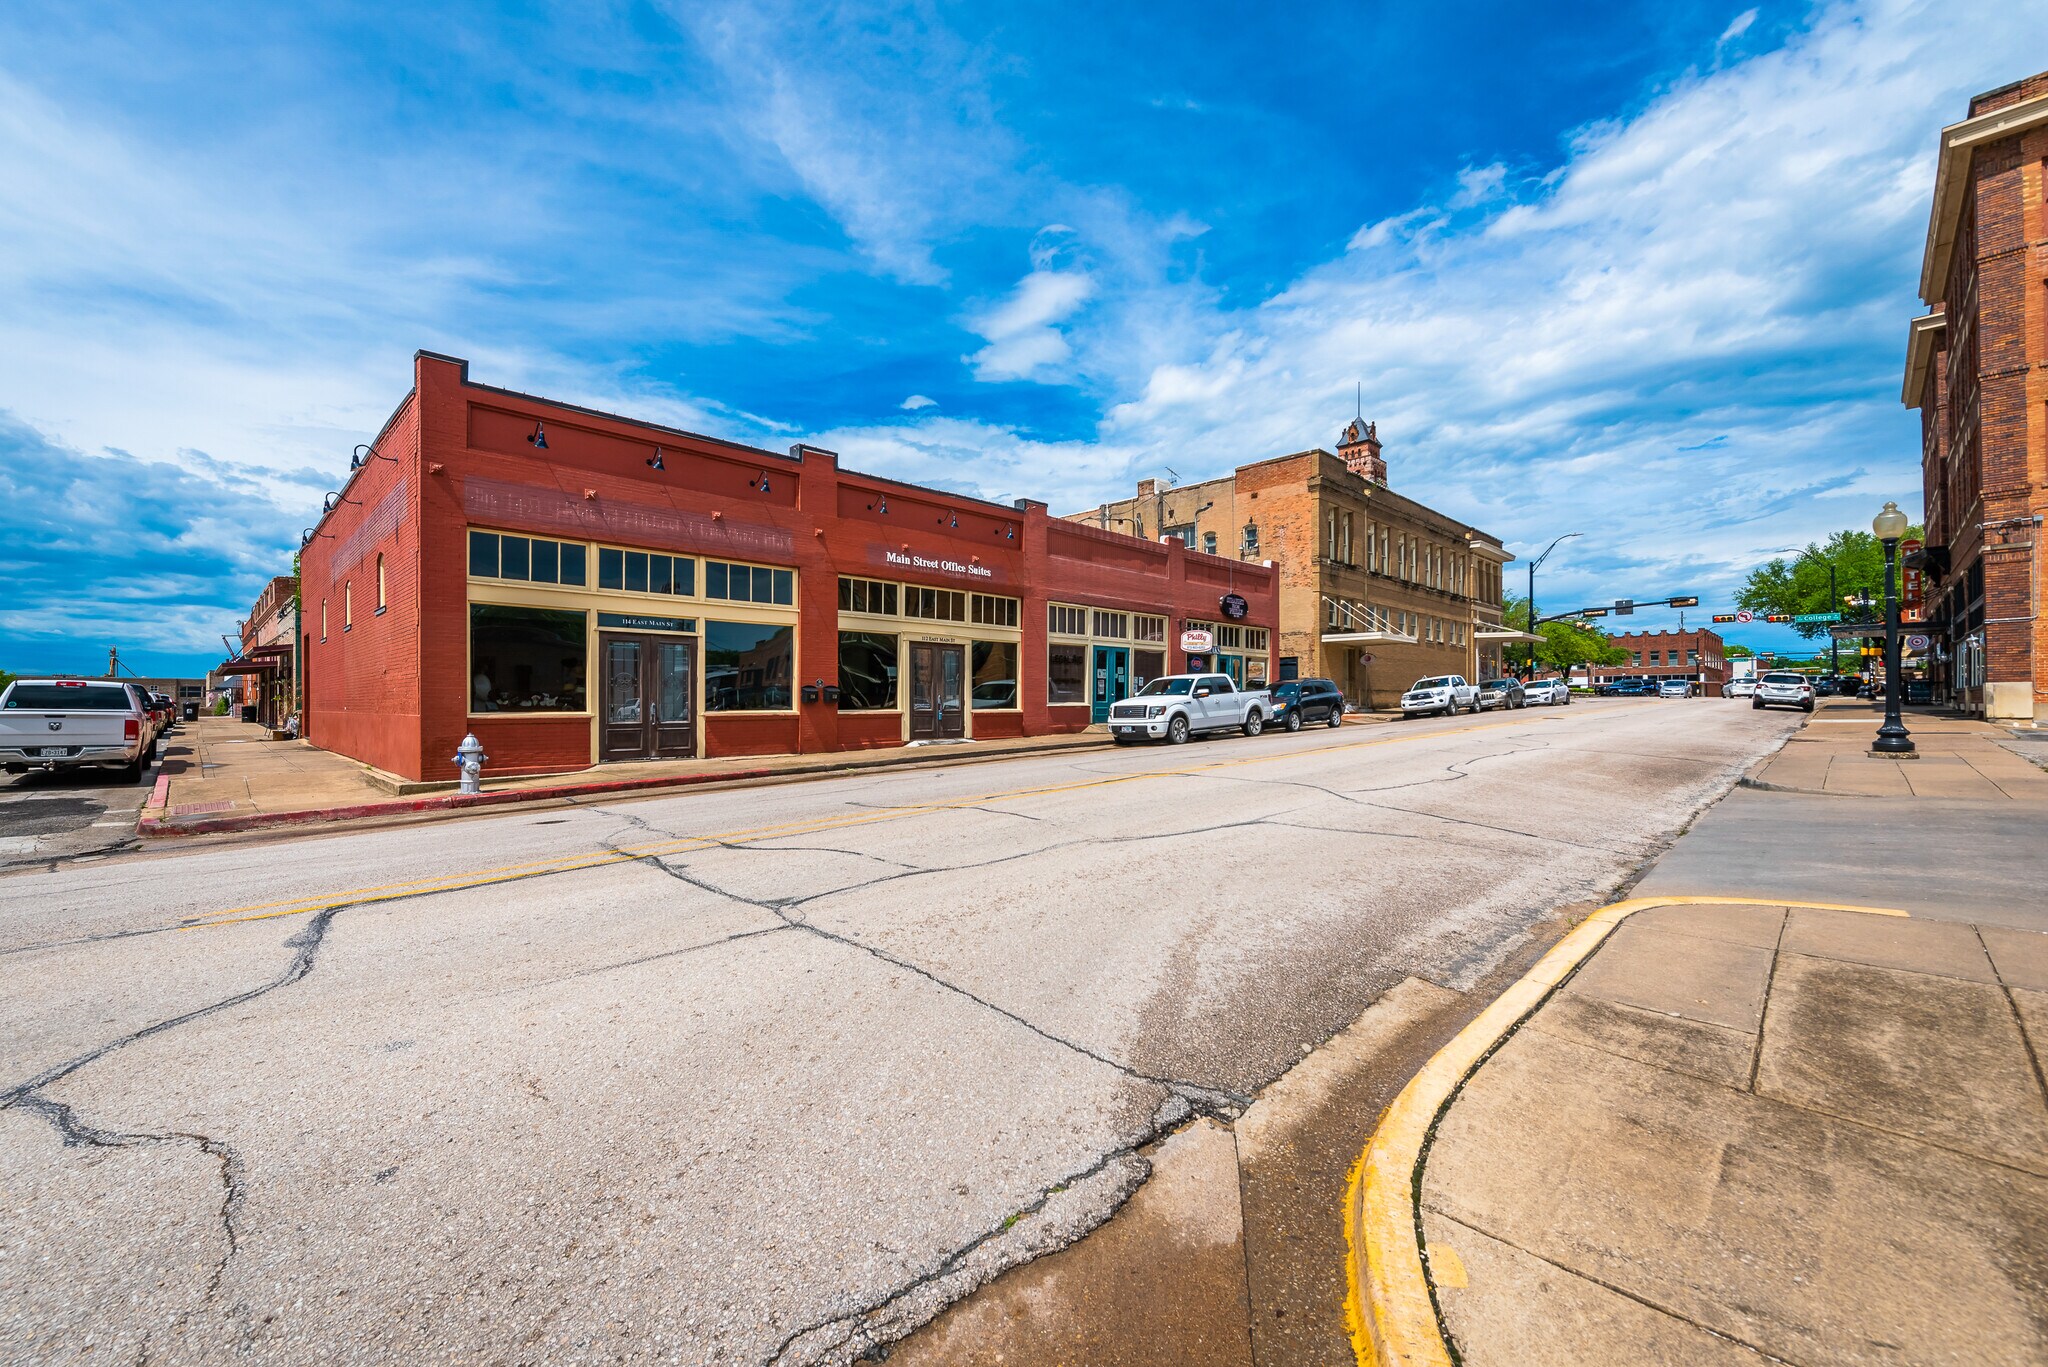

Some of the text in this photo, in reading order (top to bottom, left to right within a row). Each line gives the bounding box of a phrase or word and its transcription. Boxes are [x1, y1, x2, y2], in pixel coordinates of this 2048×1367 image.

[886, 551, 992, 577] Main Street Office Suites
[1187, 633, 1207, 642] Philly
